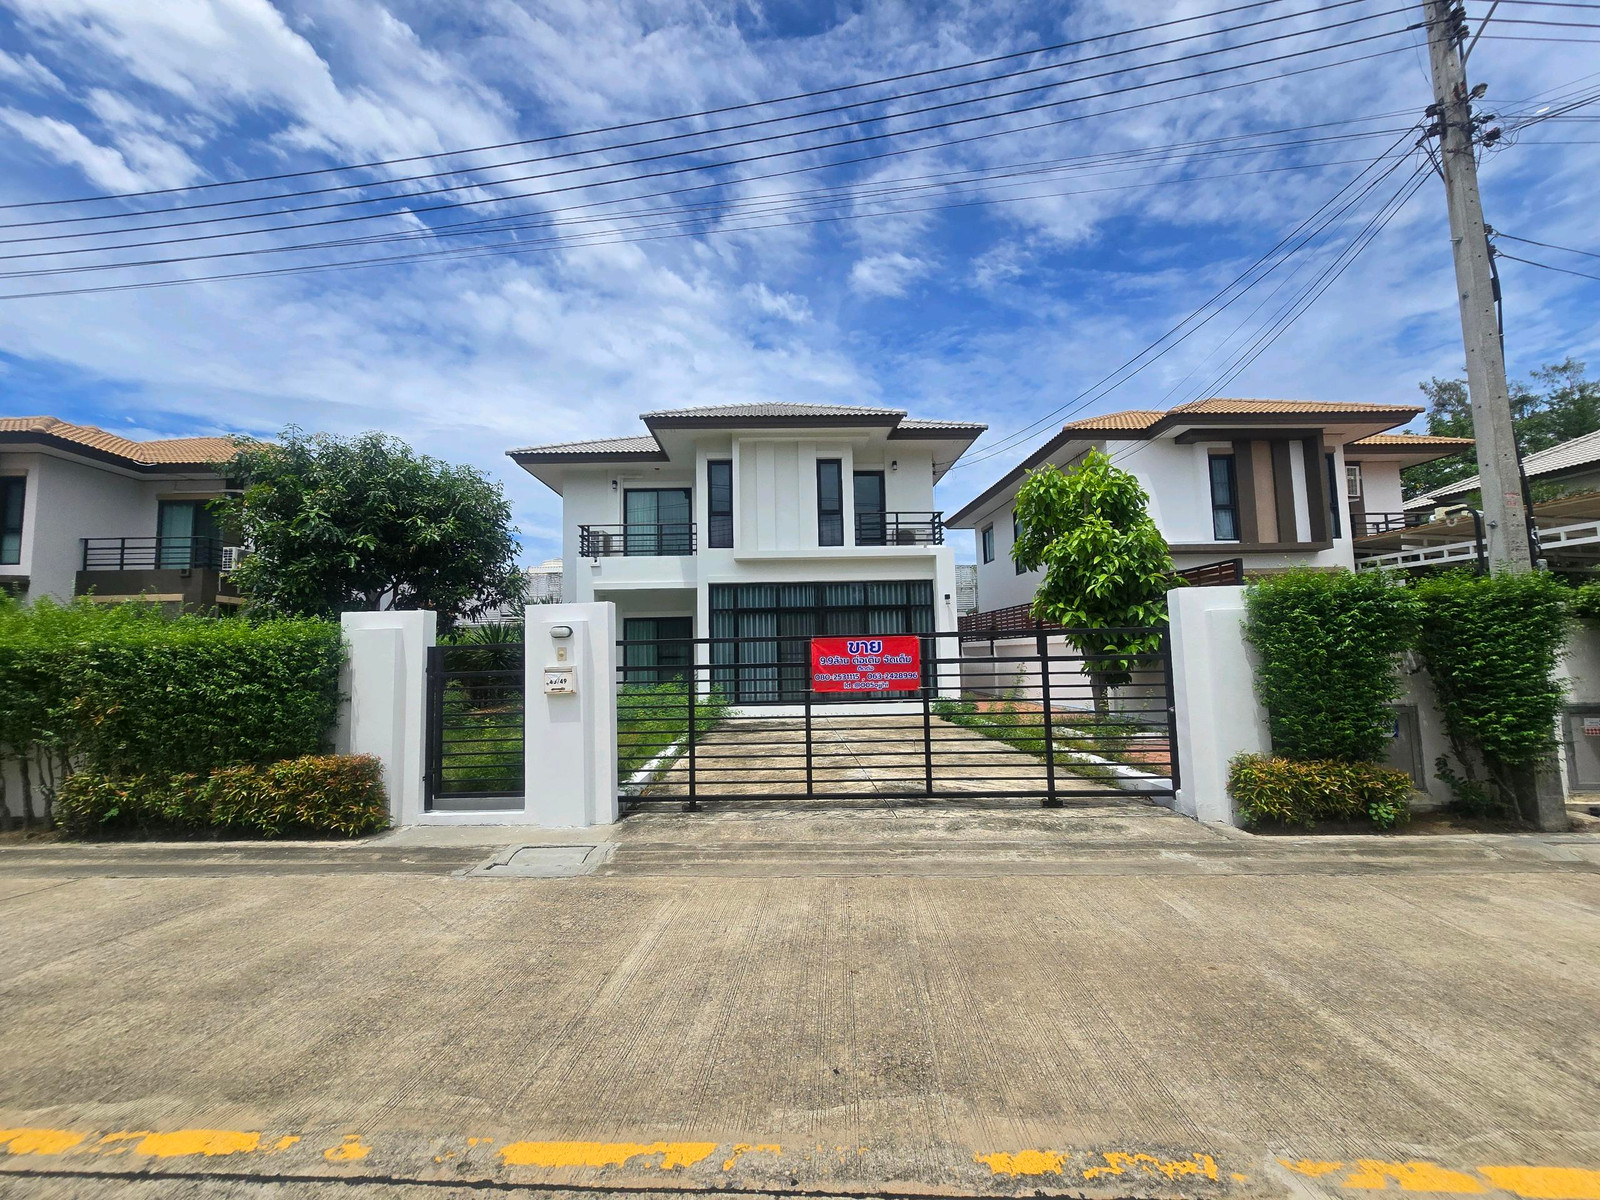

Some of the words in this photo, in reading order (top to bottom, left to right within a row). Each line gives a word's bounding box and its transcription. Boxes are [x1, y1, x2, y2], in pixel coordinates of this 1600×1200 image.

[847, 640, 882, 655] ขาย
[852, 655, 880, 665] ต่อเติม
[883, 653, 912, 664] จัดเต็ม
